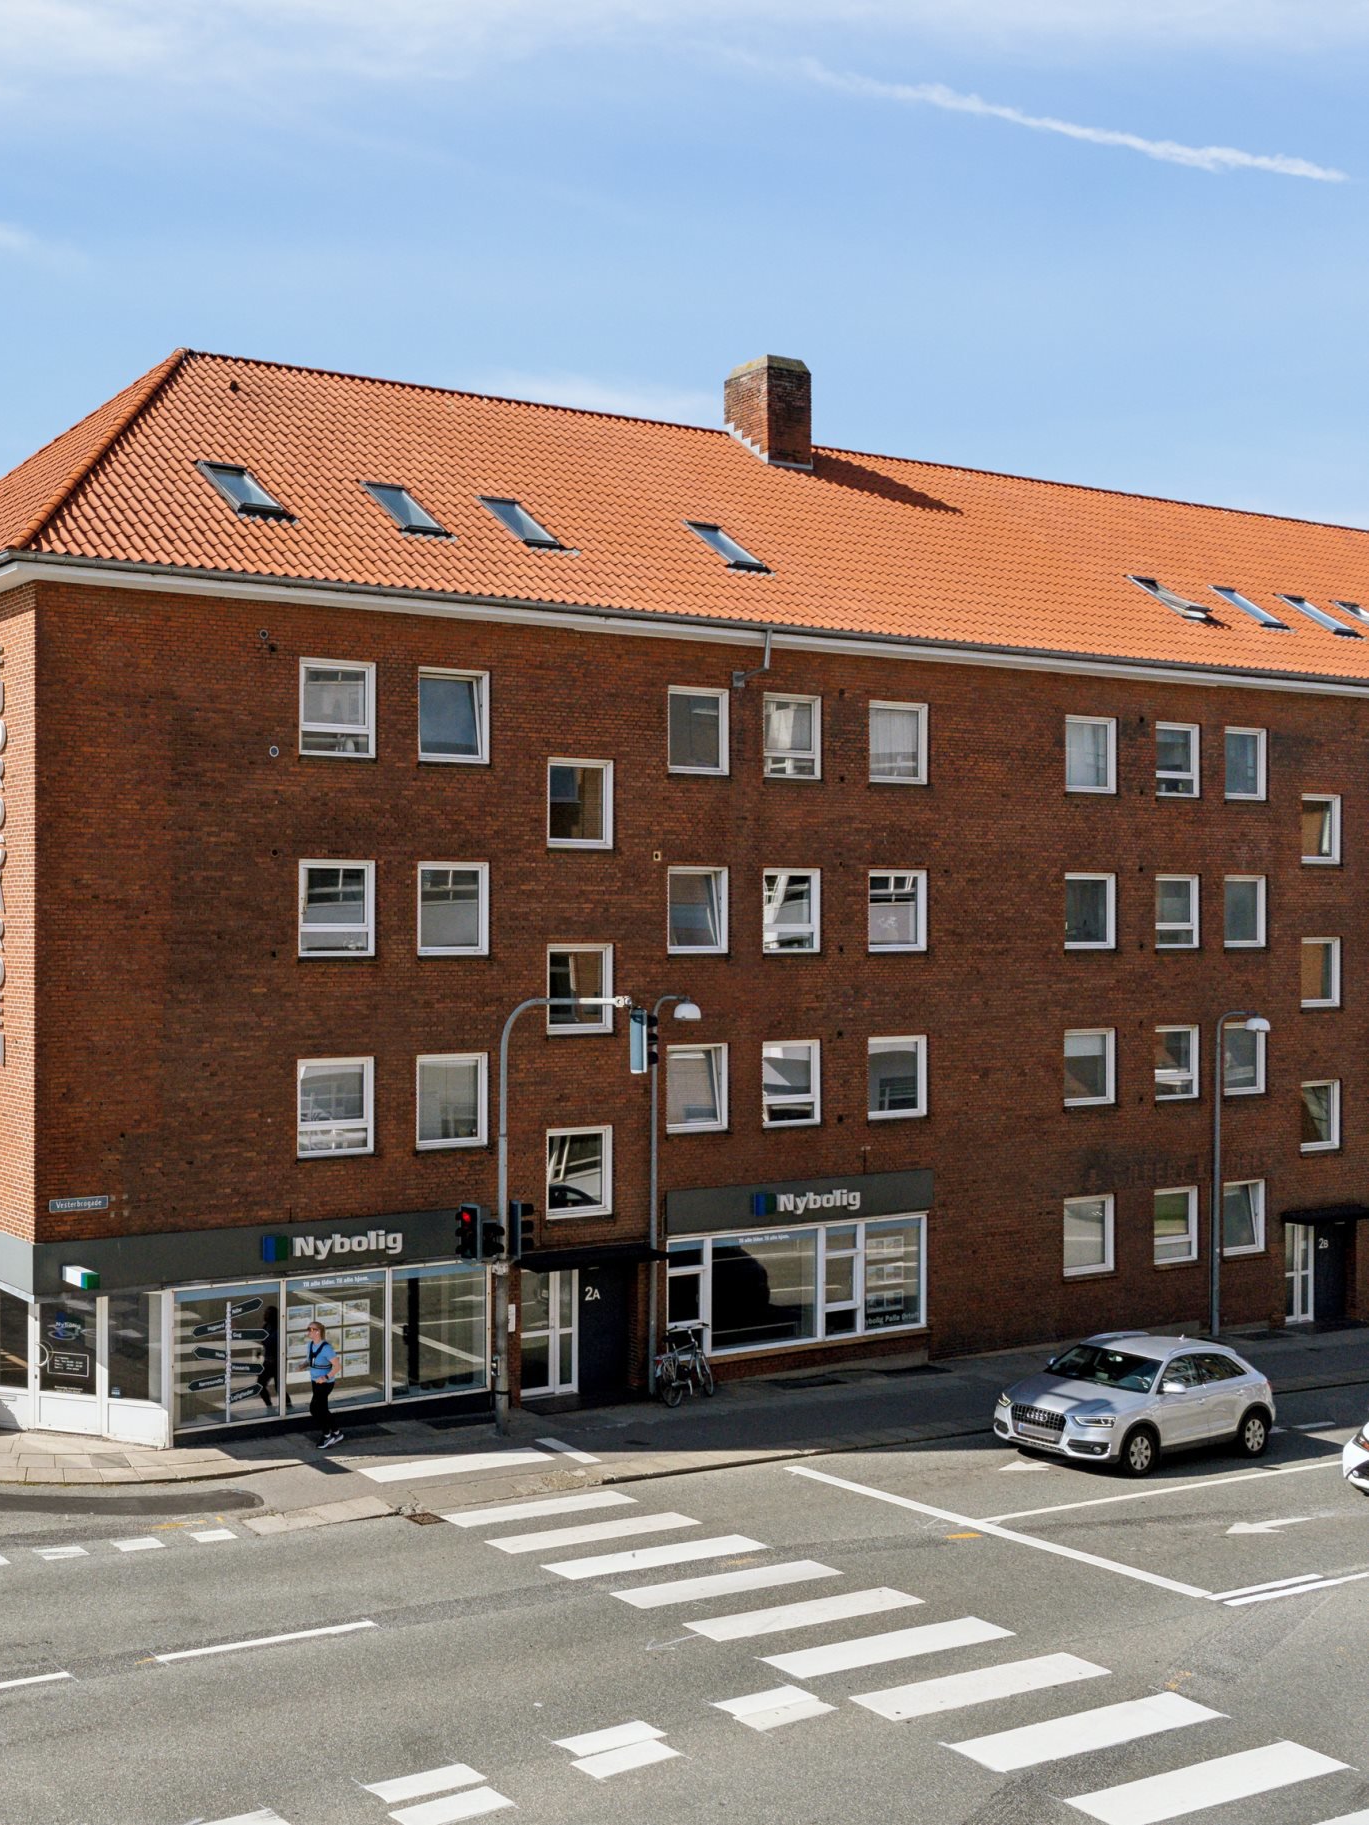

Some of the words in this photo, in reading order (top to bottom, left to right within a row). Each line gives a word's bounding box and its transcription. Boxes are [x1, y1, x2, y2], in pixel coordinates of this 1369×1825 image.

[55, 1199, 103, 1209] Vesterbrogade
[776, 1189, 861, 1215] Nybolig
[293, 1230, 403, 1260] Nybolig
[1318, 1237, 1329, 1249] 2B
[584, 1286, 601, 1301] 2A
